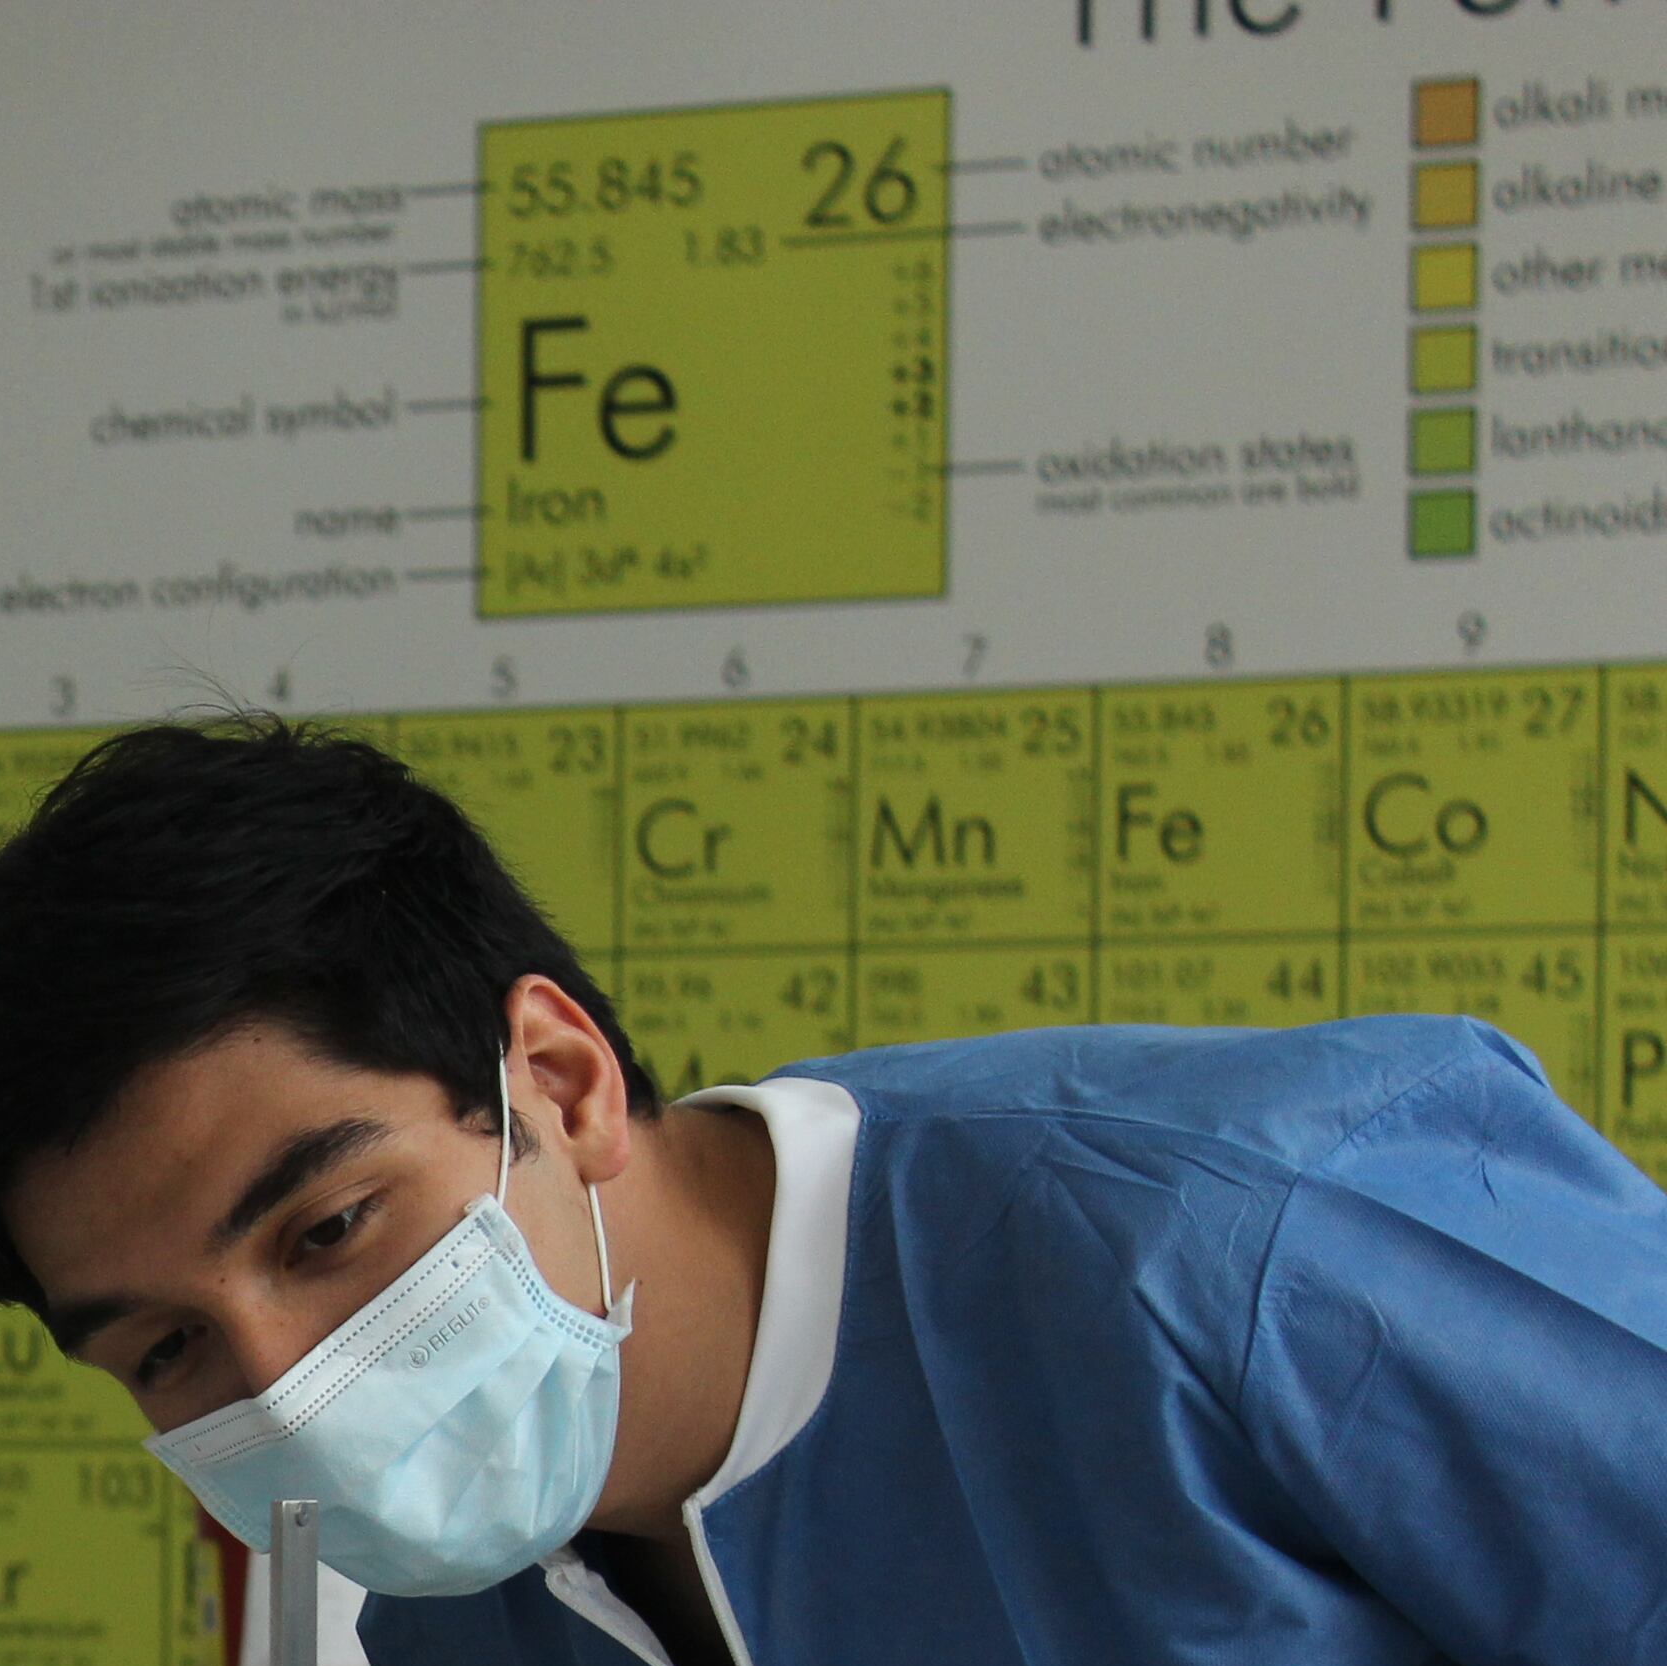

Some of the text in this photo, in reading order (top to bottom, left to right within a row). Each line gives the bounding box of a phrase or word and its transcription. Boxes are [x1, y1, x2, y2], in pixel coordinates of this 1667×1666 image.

[1494, 74, 1609, 130] alkali
[1038, 116, 1353, 180] atomic number
[170, 186, 299, 228] atomic
[506, 150, 705, 220] 55.845
[799, 136, 922, 230] 26
[1492, 157, 1663, 216] alkaline
[1038, 184, 1373, 246] electronegativity
[1491, 245, 1603, 296] other
[1491, 331, 1667, 378] transitio
[517, 311, 681, 466] Fe
[92, 386, 397, 446] chemical symbol
[1037, 432, 1356, 482] oxidation states
[294, 506, 402, 538] name
[505, 476, 608, 528] Iron
[1489, 483, 1667, 543] actinoid
[151, 558, 395, 613] configuration
[965, 633, 986, 676] 7
[1458, 609, 1487, 654] 9
[1020, 706, 1082, 756] 25
[1268, 696, 1331, 748] 26
[1521, 684, 1586, 739] 27
[548, 722, 607, 774] 23
[780, 716, 840, 766] 24
[633, 796, 732, 880] Cr
[869, 792, 998, 870] Mn
[1115, 782, 1205, 864] Fe
[1362, 771, 1490, 859] Co
[779, 965, 839, 1015] 42
[1265, 957, 1326, 1001] 44
[1519, 948, 1585, 1000] 45
[1622, 1026, 1666, 1106] P
[78, 1464, 153, 1510] 103
